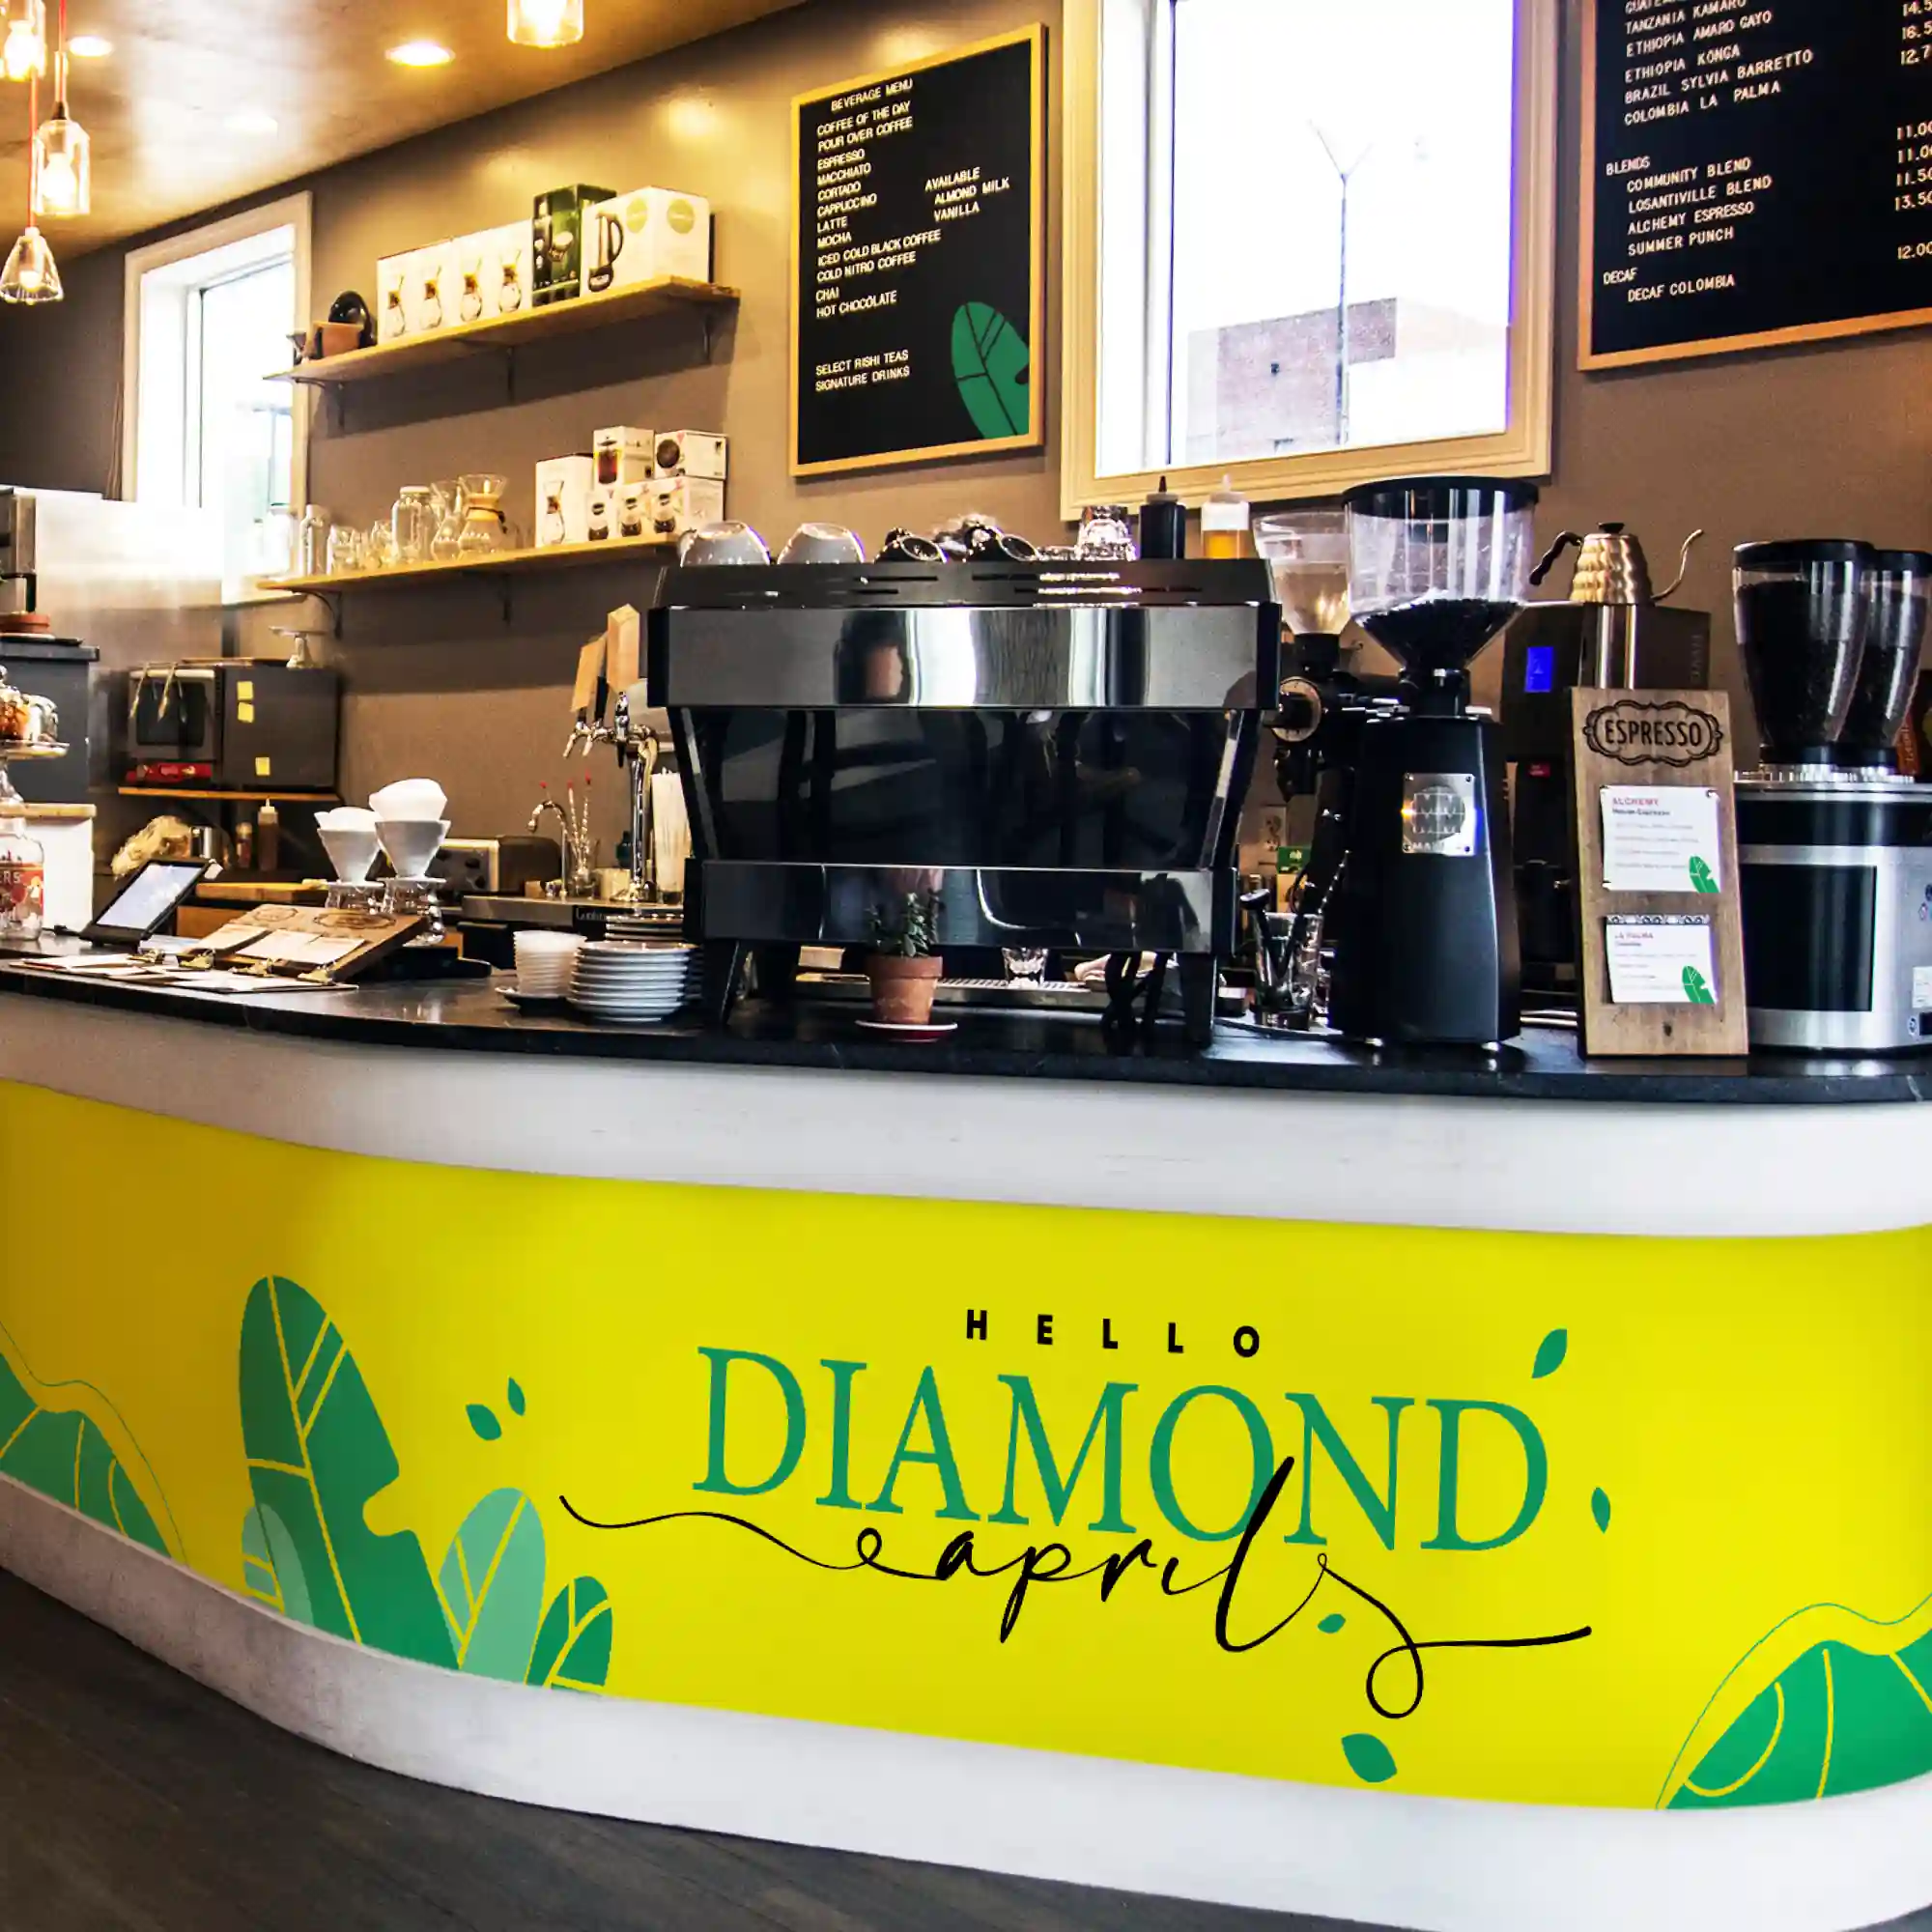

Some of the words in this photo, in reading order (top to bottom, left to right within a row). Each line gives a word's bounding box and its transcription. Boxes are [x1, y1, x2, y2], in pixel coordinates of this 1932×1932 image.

[1625, 9, 1687, 35] TANZANIA
[1692, 0, 1747, 19] KAMARO
[1626, 31, 1685, 57] ETHIOPIA
[1692, 19, 1735, 41] AMARO
[1625, 58, 1687, 83] ETHIOPIA
[1625, 82, 1671, 104] BRAZIL
[1681, 70, 1729, 92] SYLVIA
[1737, 48, 1814, 80] BARRETTO
[831, 87, 881, 112] BEVERAGE
[885, 77, 913, 97] MENU
[1624, 100, 1690, 127] COLOMBIA
[1699, 93, 1719, 110] LA
[1733, 80, 1781, 103] PALMA
[817, 116, 854, 136] COFFEE
[856, 112, 869, 126] OF
[873, 106, 890, 121] THE
[893, 100, 910, 116] DAY
[818, 135, 844, 153] POUR
[846, 128, 874, 145] OVER
[875, 116, 913, 136] COFFEE
[817, 148, 866, 171] ESPRESSO
[1605, 156, 1651, 176] BLENDS
[1897, 144, 1932, 164] 11.0
[817, 162, 871, 186] MACCHIATO
[925, 166, 980, 192] AVAILABLE
[1627, 166, 1698, 193] COMMUNITY
[1707, 156, 1752, 178] BLEND
[817, 181, 862, 202] CORTADO
[935, 184, 978, 205] ALMOND
[981, 176, 1010, 194] MILK
[1629, 185, 1718, 214] LOSANTIVILLE
[1725, 174, 1774, 197] BLEND
[817, 193, 877, 219] CAPPUCCINO
[933, 201, 980, 223] VANILLA
[1628, 213, 1687, 236] ALCHEMY
[1693, 201, 1754, 224] ESPRESSO
[817, 216, 848, 234] LATTE
[817, 232, 852, 249] MOCHA
[817, 252, 840, 267] ICED
[843, 245, 869, 262] COLD
[871, 238, 902, 255] BLACK
[902, 228, 942, 249] COFFEE
[1628, 235, 1684, 257] SUMMER
[1689, 226, 1735, 247] PUNCH
[816, 267, 842, 284] COLD
[844, 259, 875, 278] NITRO
[877, 251, 917, 270] COFFEE
[1603, 267, 1638, 286] DECAF
[815, 286, 840, 303] CHAI
[1627, 284, 1665, 303] DECAF
[1669, 273, 1735, 297] COLOMBIA
[816, 304, 837, 319] HOT
[838, 290, 896, 315] CHOCOLATE
[815, 359, 852, 377] SELECT
[854, 355, 881, 369] RISHI
[883, 349, 909, 364] TEAS
[815, 372, 869, 392] SIGNATURE
[871, 365, 910, 383] DRINKS
[1605, 719, 1702, 747] ESPRESSO
[966, 1309, 1260, 1358] HELLO
[692, 1347, 1548, 1551] DIAMOND
